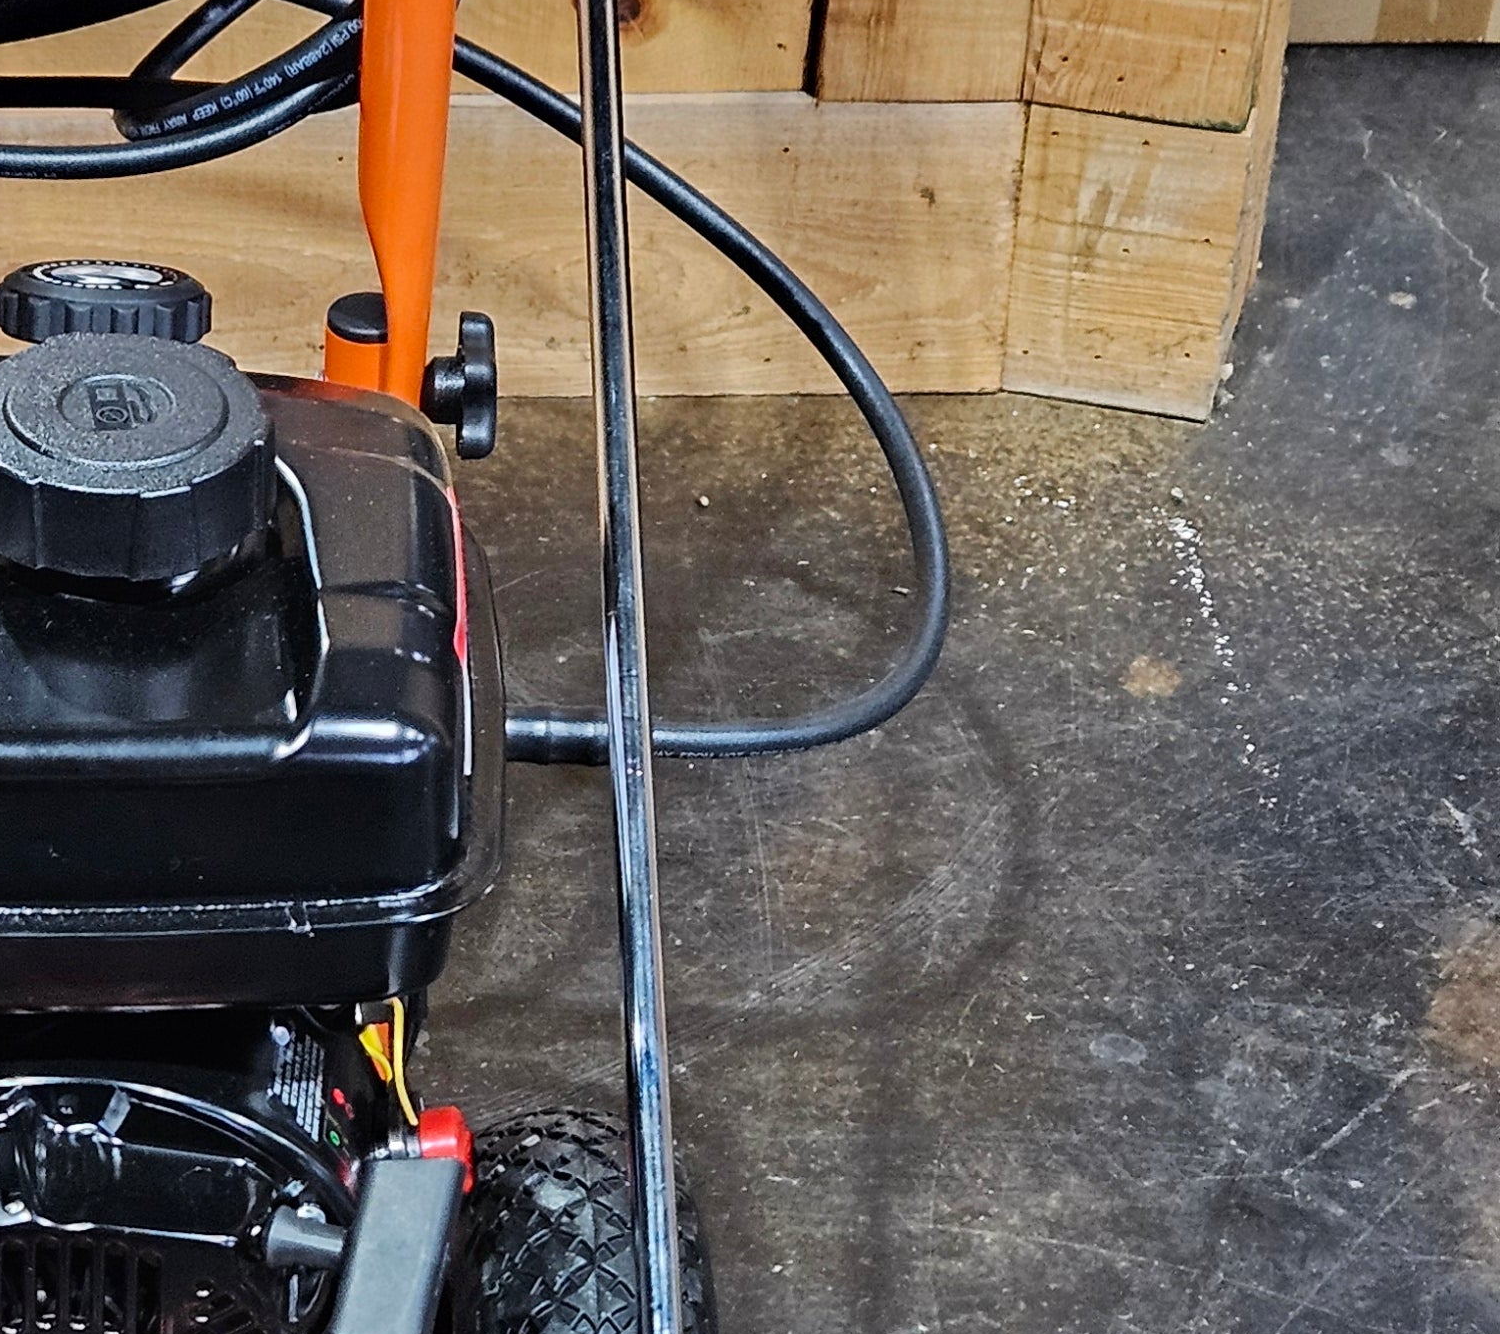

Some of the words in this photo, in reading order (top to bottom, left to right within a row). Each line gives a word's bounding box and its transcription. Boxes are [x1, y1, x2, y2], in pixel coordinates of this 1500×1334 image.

[330, 29, 350, 48] PSI
[283, 40, 332, 78] (248BAR)
[192, 100, 219, 122] KEEP
